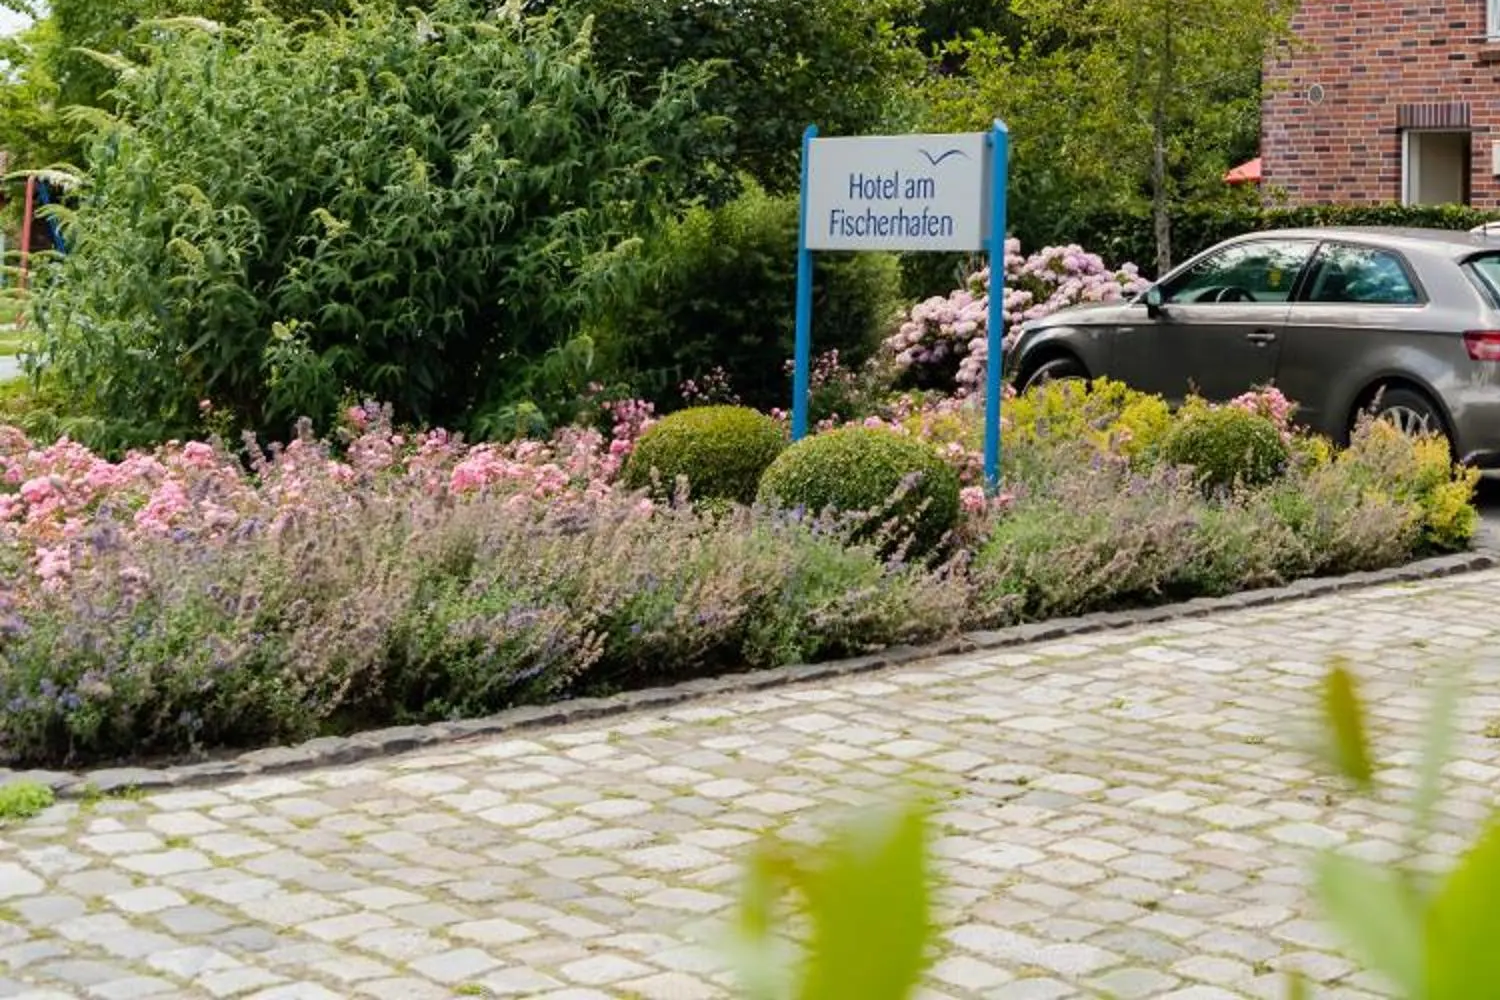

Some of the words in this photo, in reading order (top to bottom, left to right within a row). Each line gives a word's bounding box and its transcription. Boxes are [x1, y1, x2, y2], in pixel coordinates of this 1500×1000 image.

[849, 171, 898, 199] Hotel
[904, 176, 934, 199] am
[829, 206, 953, 237] Fischerhafen
